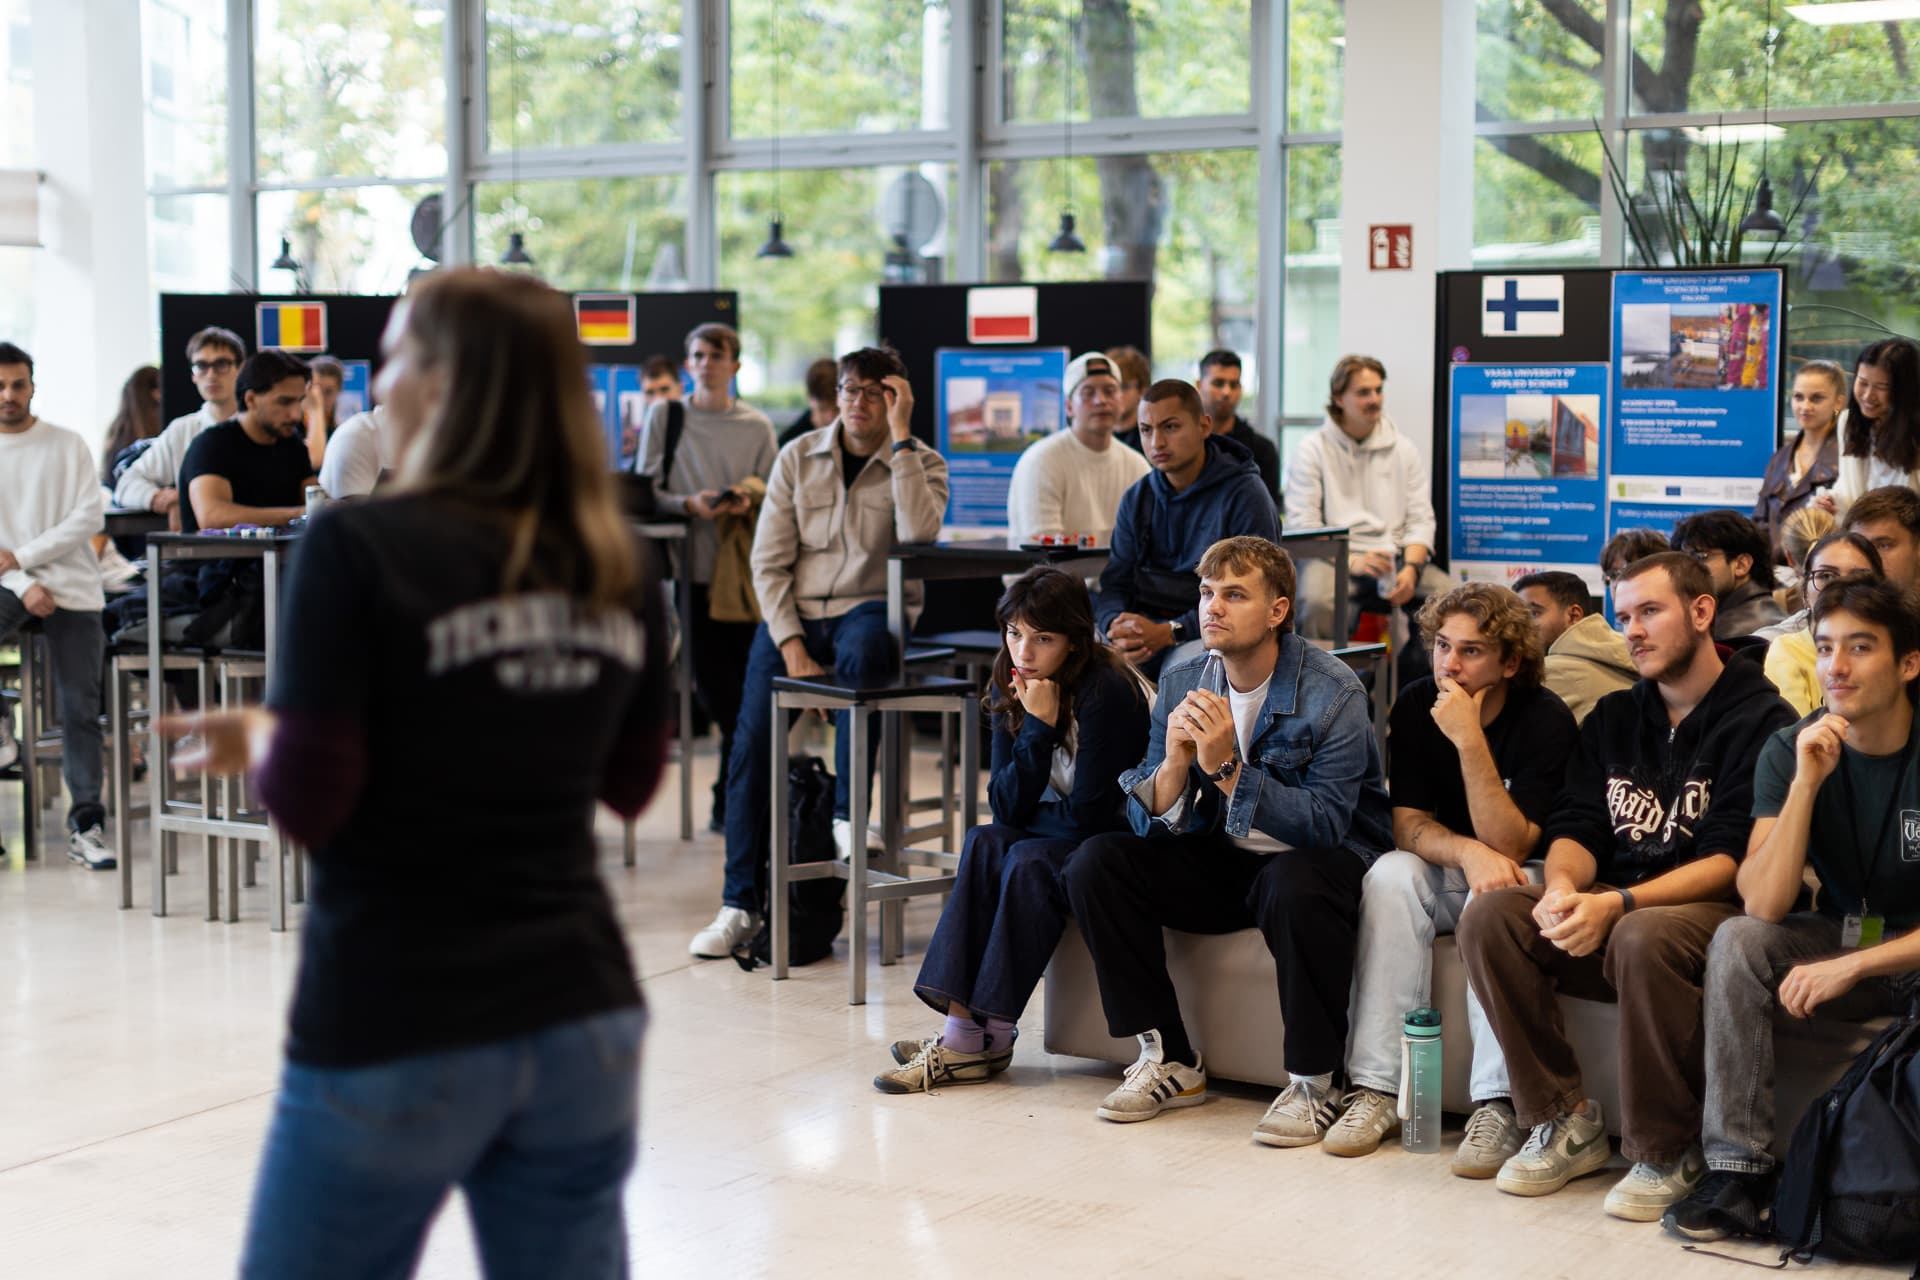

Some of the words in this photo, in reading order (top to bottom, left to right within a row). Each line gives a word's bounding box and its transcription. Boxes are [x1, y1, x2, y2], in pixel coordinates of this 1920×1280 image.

[1664, 285, 1699, 294] SCIENCES
[1514, 368, 1562, 378] UNIVERSITY
[1563, 368, 1576, 377] OF
[1491, 379, 1527, 389] APPLIED
[1528, 379, 1569, 389] SCIENCES
